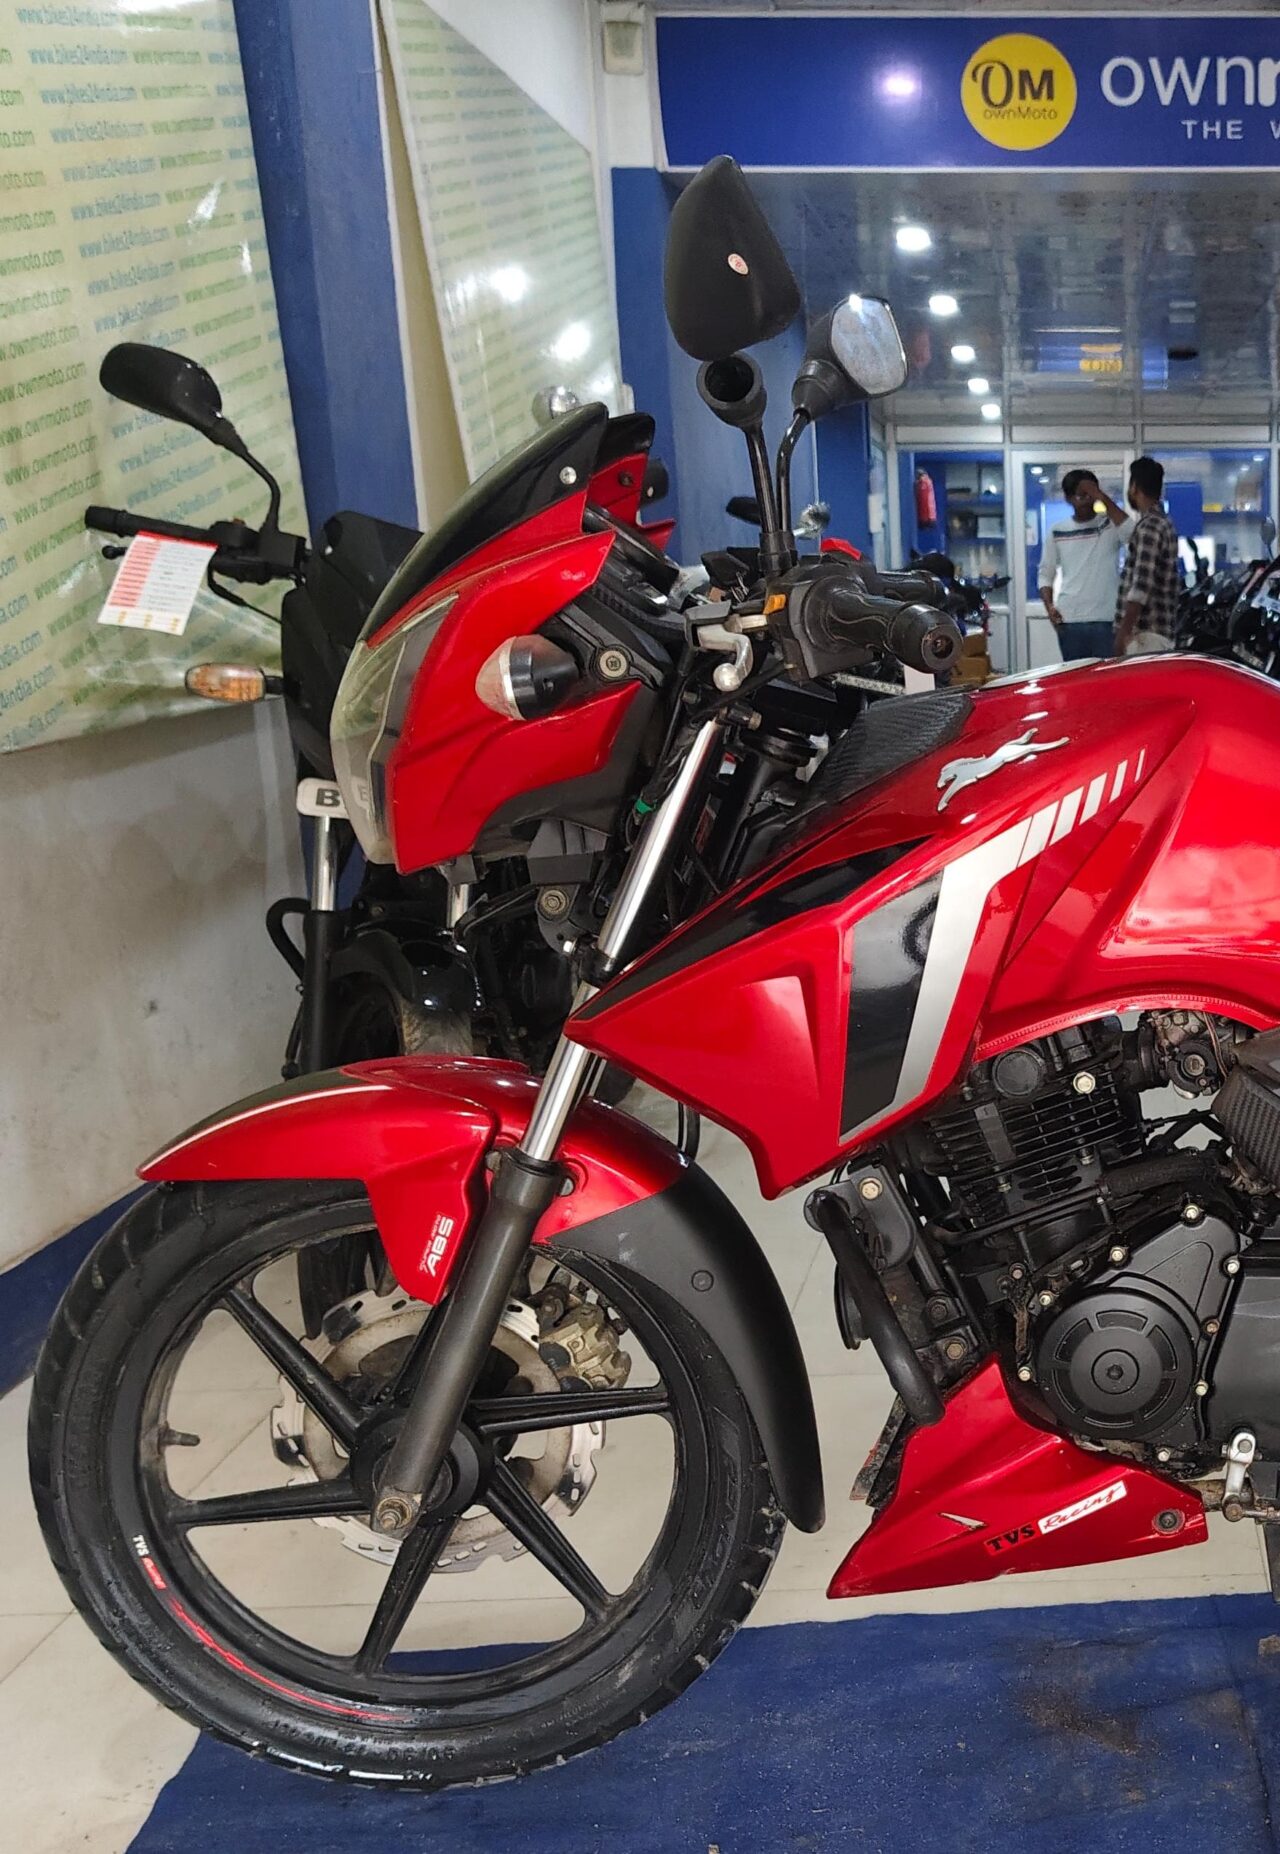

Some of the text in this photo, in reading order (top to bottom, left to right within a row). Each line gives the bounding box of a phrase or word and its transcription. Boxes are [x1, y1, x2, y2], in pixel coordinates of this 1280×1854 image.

[972, 60, 1054, 109] OM
[983, 106, 1058, 120] ownMoto
[1181, 119, 1243, 140] THE
[427, 1216, 455, 1278] ABS
[987, 1484, 1122, 1552] TVS Racing
[132, 1535, 149, 1556] TVS
